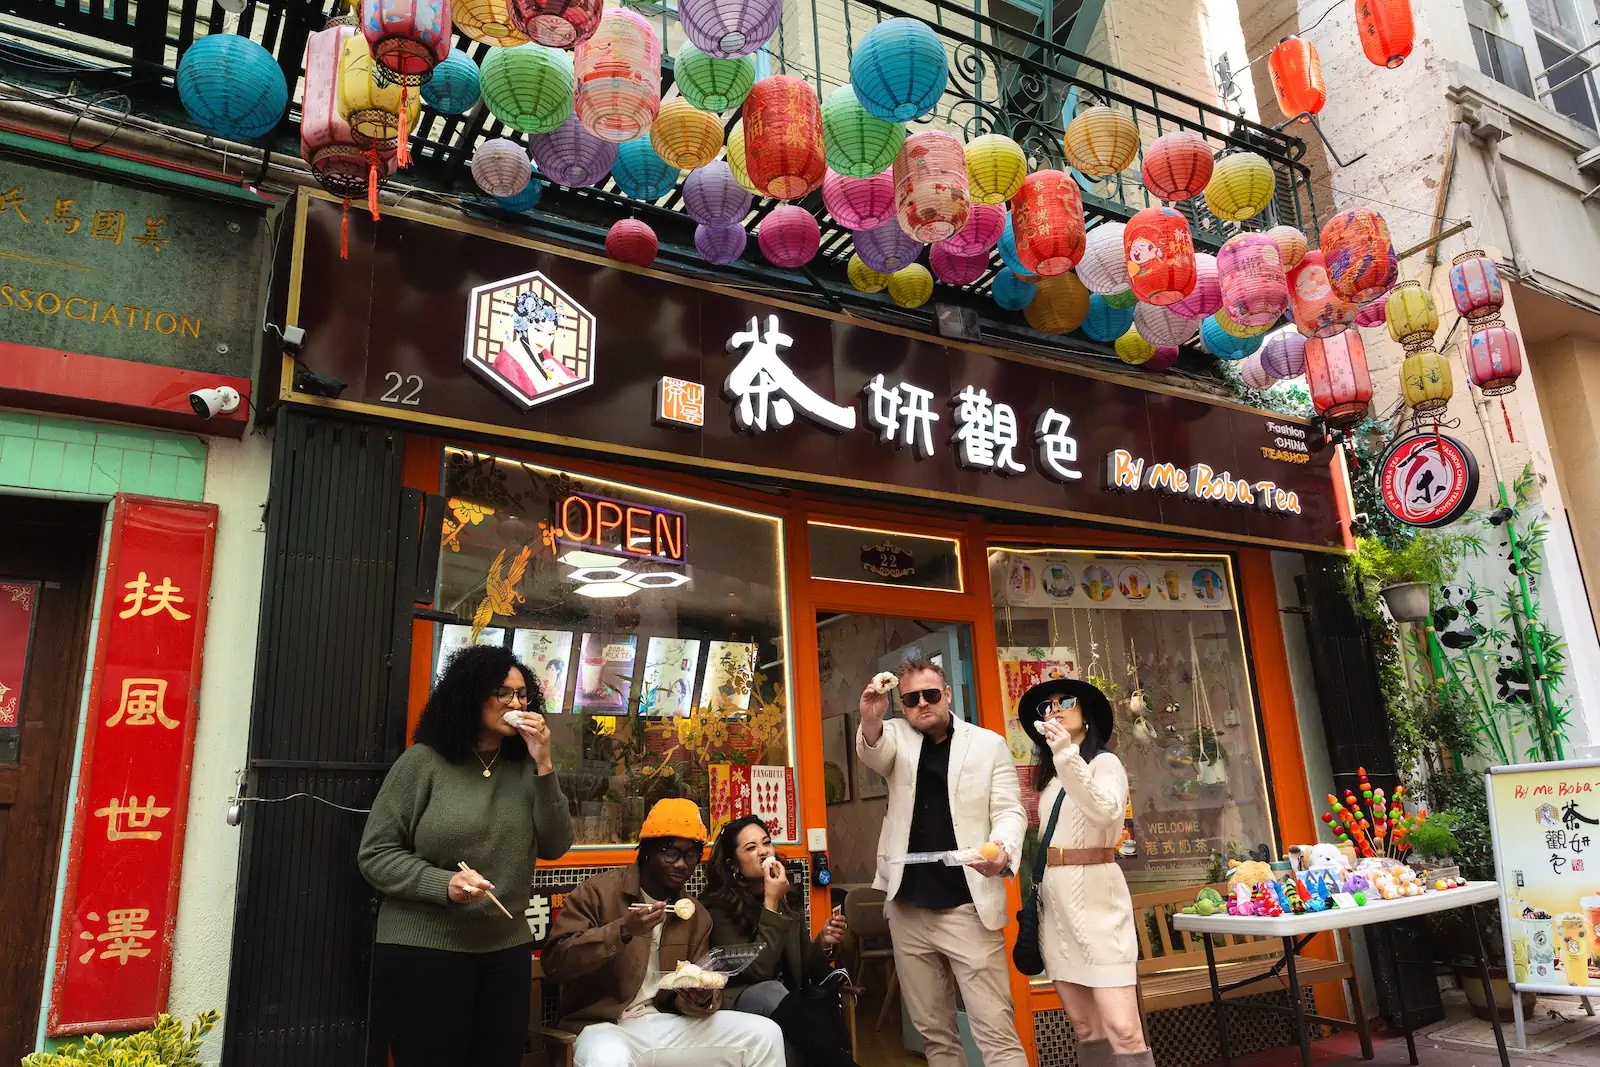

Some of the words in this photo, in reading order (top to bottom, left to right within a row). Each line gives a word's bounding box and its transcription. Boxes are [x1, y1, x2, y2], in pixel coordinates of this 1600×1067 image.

[380, 371, 424, 405] 22
[1265, 421, 1306, 439] Fashion
[1274, 437, 1308, 452] CHINA
[1260, 447, 1310, 464] TEASHOP
[1389, 456, 1400, 468] TEA
[1442, 445, 1461, 469] FASHION
[1113, 449, 1145, 491] By
[1149, 462, 1190, 493] Me
[1194, 463, 1255, 505] Boba
[1256, 481, 1302, 515] Tea
[1385, 470, 1394, 489] BOBA
[1455, 469, 1464, 491] CHINA
[1386, 490, 1395, 501] ME
[1434, 491, 1460, 515] TEASHOP
[561, 495, 682, 561] OPEN
[880, 553, 897, 567] 22
[621, 652, 633, 660] TEA
[753, 769, 784, 779] TANGHULU
[1515, 785, 1529, 799] By
[1533, 785, 1553, 796] Me
[1558, 782, 1592, 796] Boba
[1148, 821, 1200, 834] WELCOME
[1145, 839, 1208, 856] 港式奶茶
